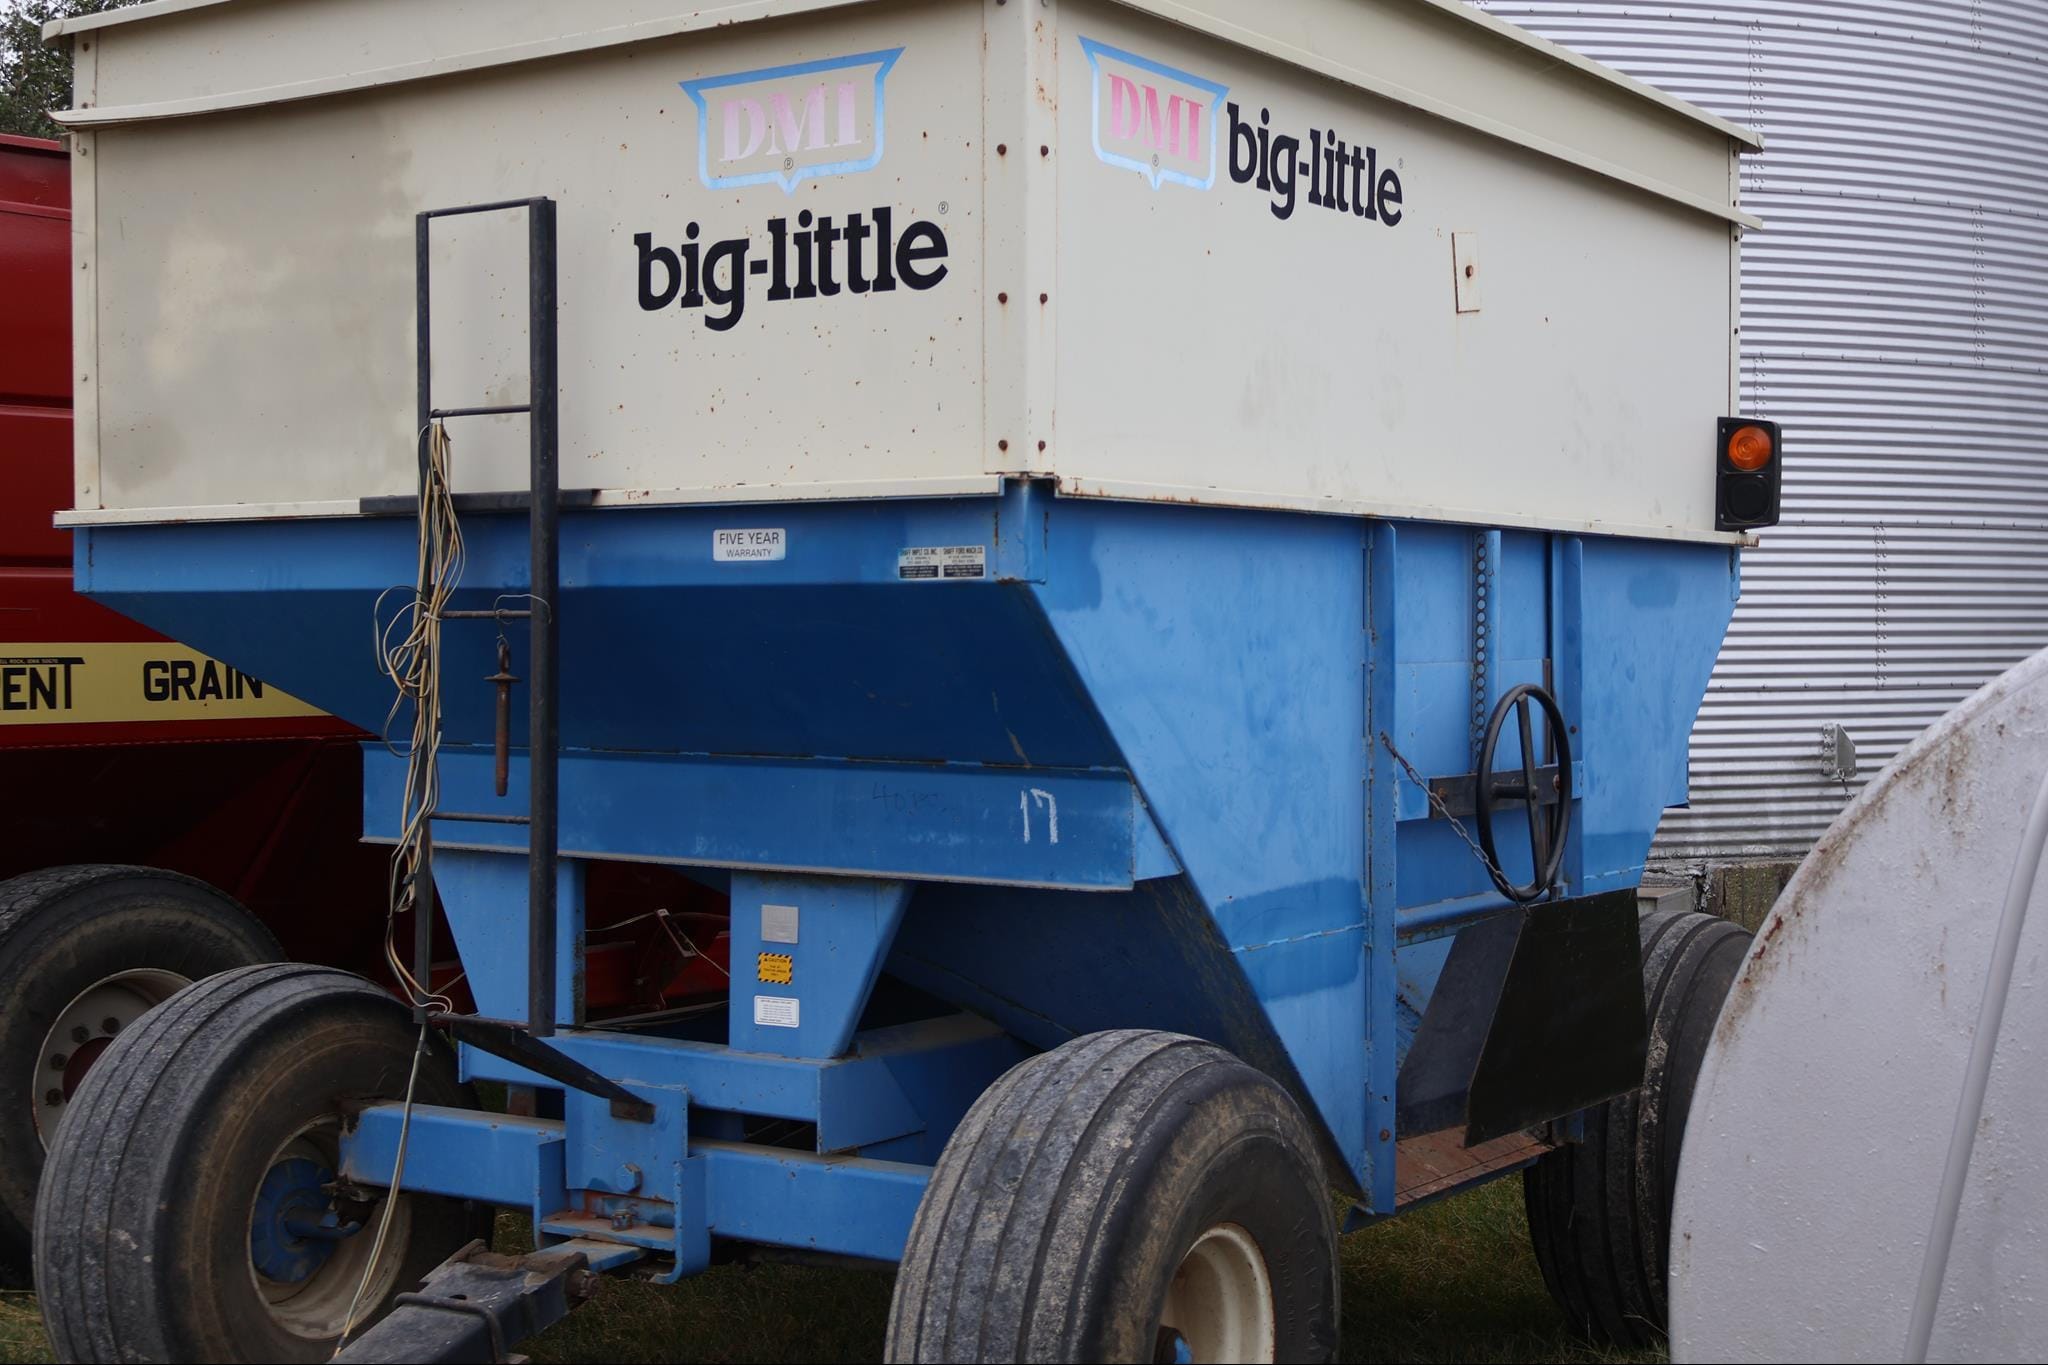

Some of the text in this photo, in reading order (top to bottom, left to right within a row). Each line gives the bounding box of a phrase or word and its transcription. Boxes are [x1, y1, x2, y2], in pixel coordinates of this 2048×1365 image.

[719, 82, 862, 162] DMI
[1107, 74, 1205, 162] DMI
[1226, 101, 1403, 227] big-little
[634, 206, 949, 332] big-little
[719, 531, 780, 545] FIVE YEAR
[726, 548, 772, 557] WARRANTY
[0, 657, 264, 710] ENT GRAIN
[1020, 788, 1058, 844] 17
